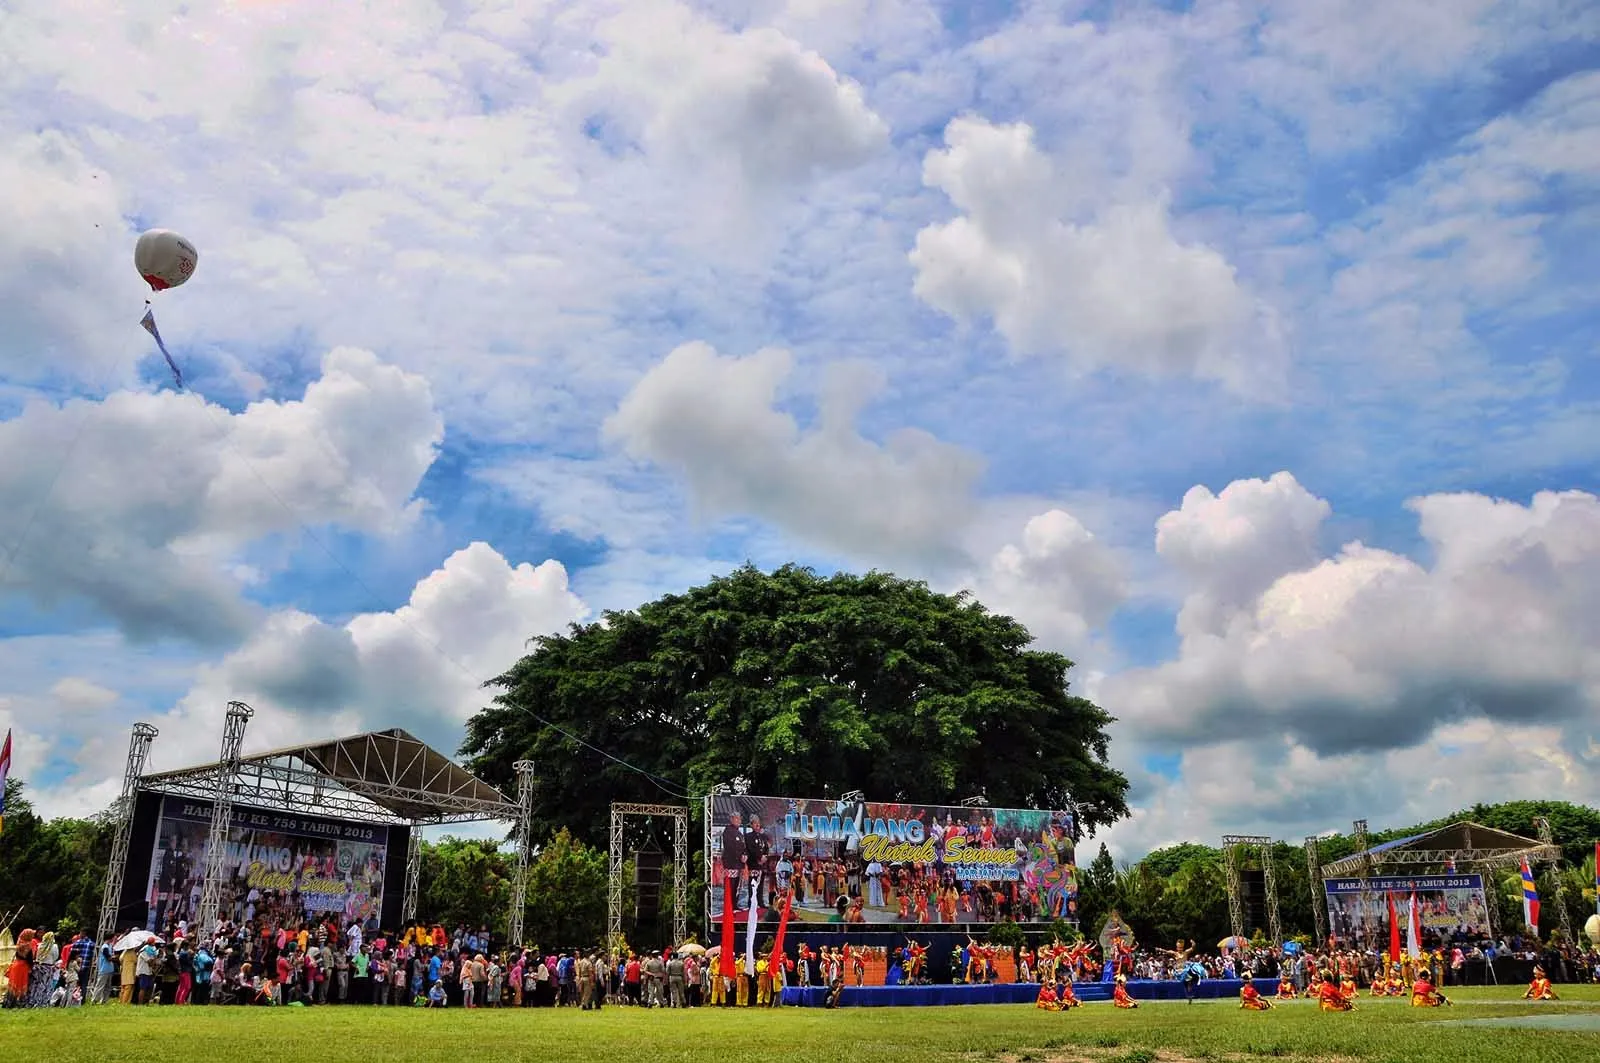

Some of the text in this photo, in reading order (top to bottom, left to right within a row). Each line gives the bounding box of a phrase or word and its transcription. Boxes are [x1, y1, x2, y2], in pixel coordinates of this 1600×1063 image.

[183, 804, 374, 839] HARLU KE 758 TAHUN 2013
[784, 813, 925, 844] LUMAJANG
[203, 839, 291, 871] MAJANG
[860, 833, 1019, 865] Untuk Semua
[1381, 881, 1393, 889] KE
[1415, 879, 1445, 888] TAHUN
[1447, 878, 1470, 887] 2013
